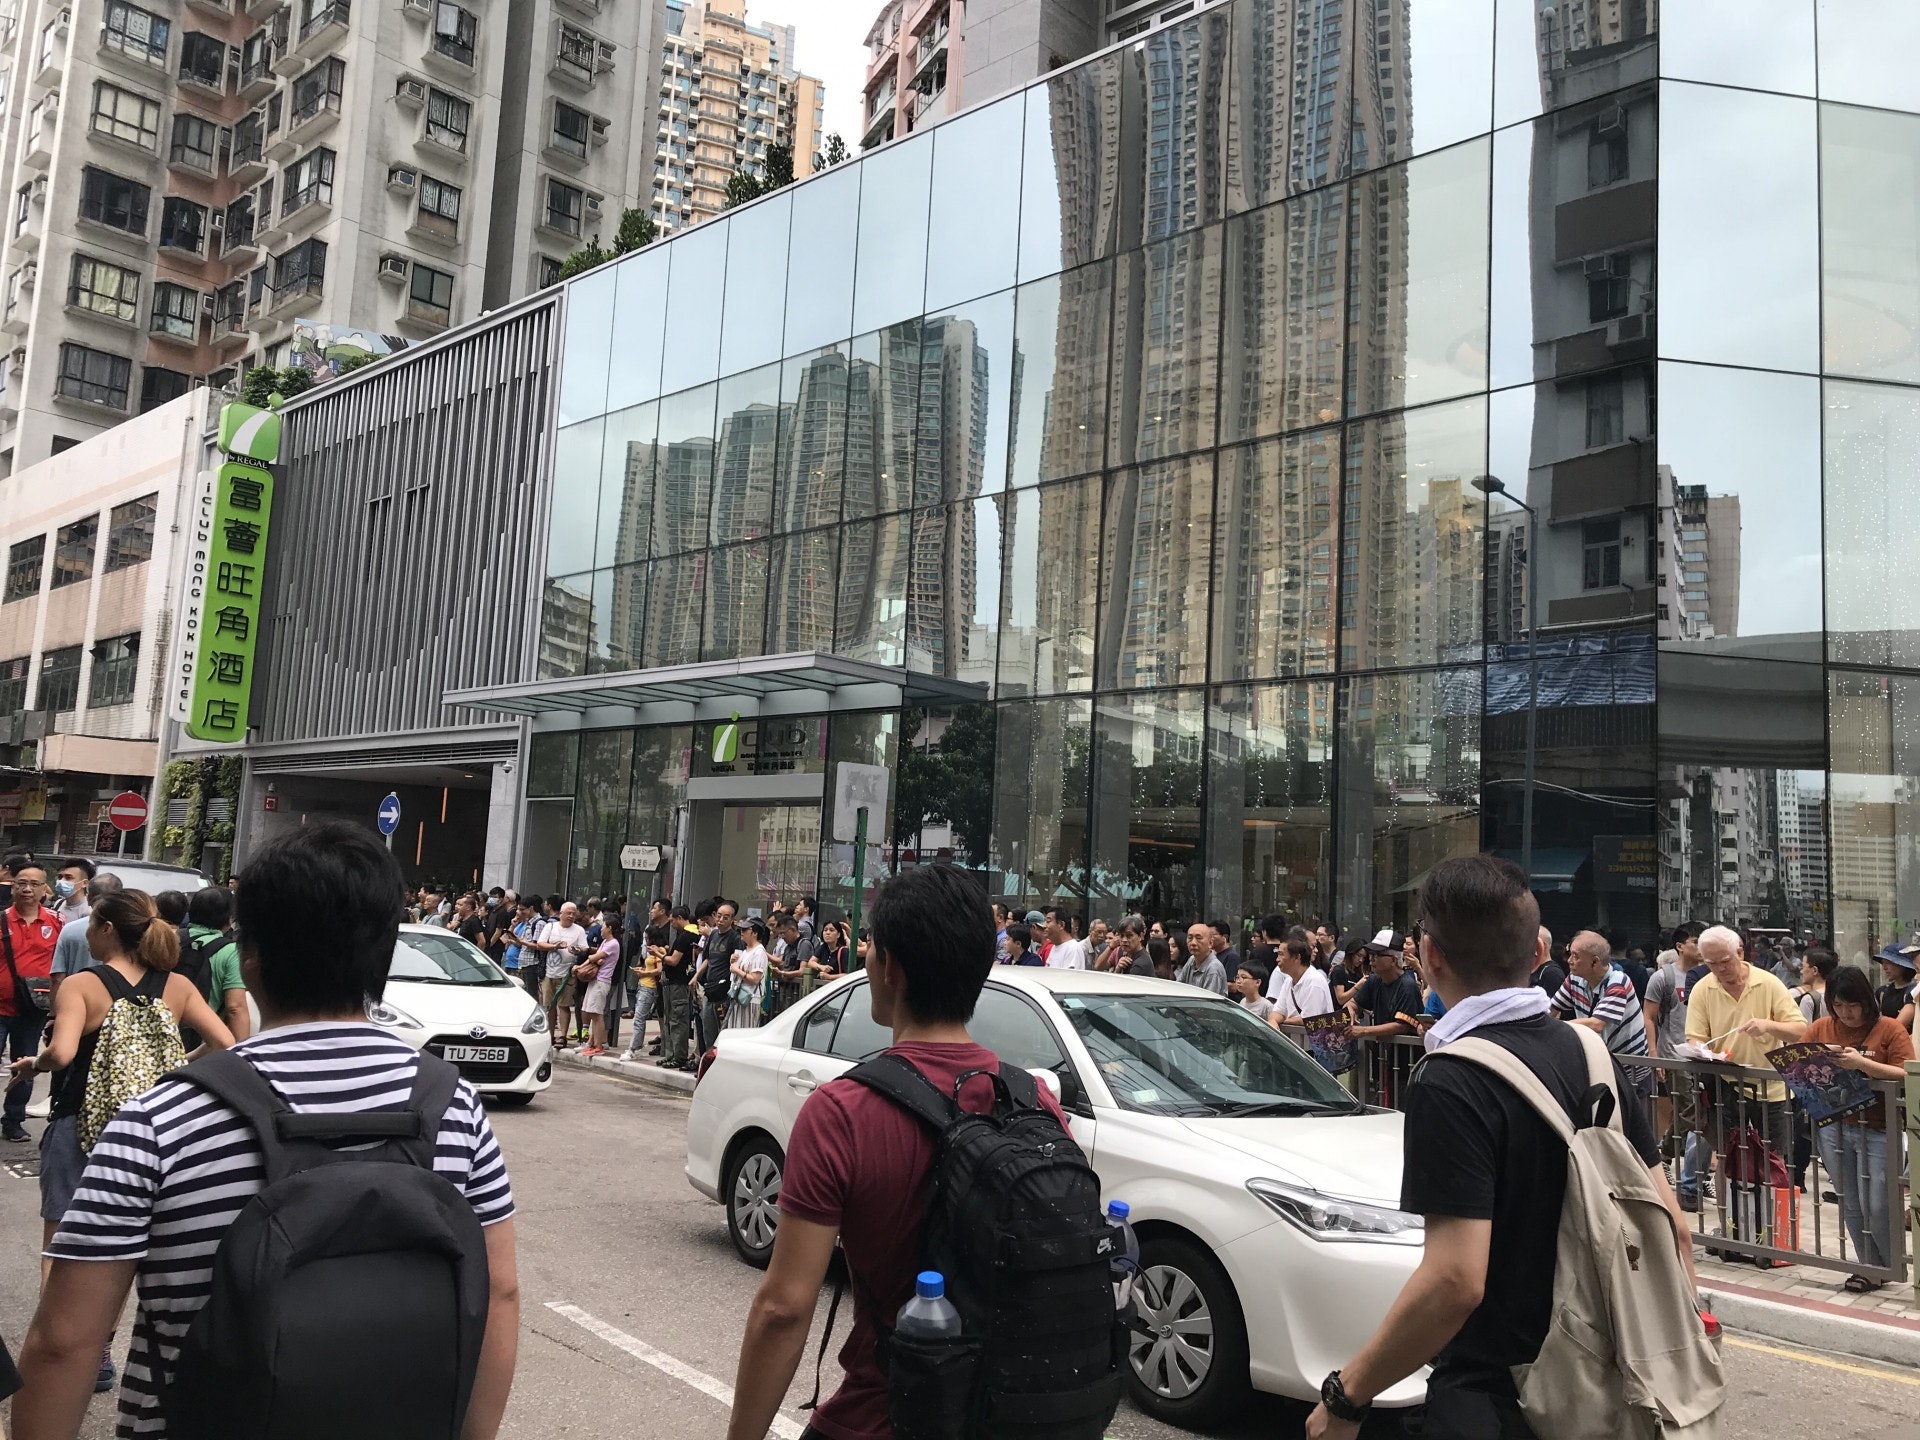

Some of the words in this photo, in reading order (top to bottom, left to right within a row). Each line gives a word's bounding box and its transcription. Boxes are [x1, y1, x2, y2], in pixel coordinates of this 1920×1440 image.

[236, 455, 268, 469] REGAL
[201, 476, 265, 731] 富薈旺角酒店
[186, 606, 198, 642] KOK
[178, 650, 194, 712] HOTEL
[448, 1048, 466, 1060] TU
[470, 1048, 505, 1061] 7568
